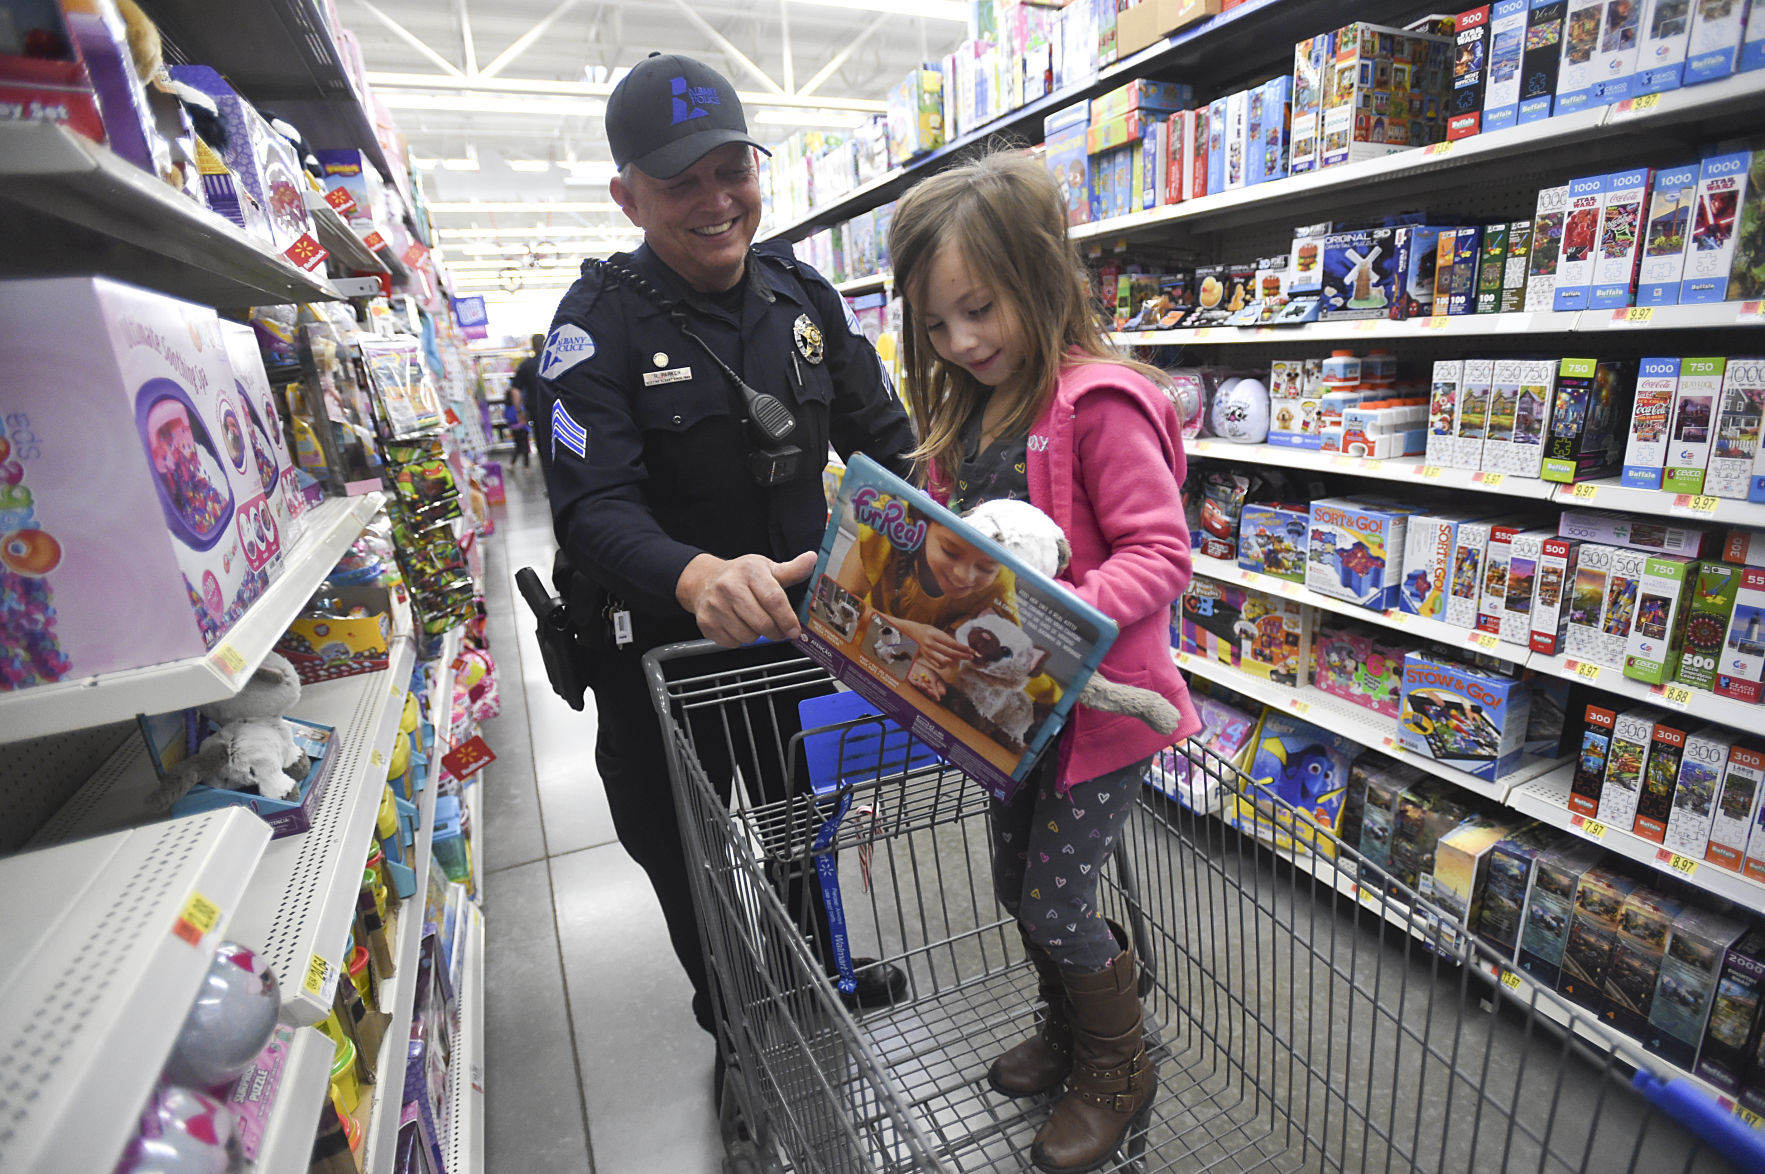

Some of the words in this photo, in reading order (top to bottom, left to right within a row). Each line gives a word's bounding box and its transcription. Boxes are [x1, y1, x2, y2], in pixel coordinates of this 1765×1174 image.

[1498, 1, 1523, 14] 1000
[1461, 12, 1482, 26] 500
[1456, 32, 1484, 46] WARS
[1460, 26, 1484, 39] STAR
[1522, 102, 1547, 113] Buffalo
[1635, 95, 1658, 110] 9.97
[1451, 118, 1475, 129] Buffalo
[1707, 160, 1741, 174] 1000
[1612, 174, 1641, 187] 1000
[1660, 173, 1692, 186] 1000
[1708, 177, 1736, 187] STAR
[1574, 181, 1600, 193] 1000
[1705, 181, 1736, 192] WARS
[1539, 189, 1568, 209] 1000
[1573, 200, 1597, 209] WARS
[1574, 196, 1597, 205] STAR
[1324, 234, 1371, 245] ORIGINAL
[1373, 229, 1391, 238] 3D
[1479, 294, 1495, 302] 100
[1597, 288, 1623, 298] Buffalo
[1451, 296, 1466, 304] 100
[1629, 309, 1652, 321] 9.97
[557, 336, 586, 346] ALBANY
[556, 344, 584, 355] POLICE
[1435, 364, 1457, 378] 750
[1498, 365, 1521, 379] 750
[1524, 366, 1549, 381] 750
[1568, 364, 1589, 374] 750
[1645, 364, 1674, 374] 1000
[1690, 362, 1714, 372] 750
[1547, 464, 1571, 473] Buffalo
[1628, 470, 1656, 479] Buffalo
[1575, 486, 1595, 497] 9.97
[1693, 498, 1716, 510] 9.97
[1314, 507, 1347, 529] SORT
[1346, 515, 1354, 527] &
[1356, 516, 1383, 534] GO!
[1460, 530, 1483, 544] 500
[1495, 531, 1513, 541] 550
[1568, 527, 1589, 537] 500
[1435, 524, 1452, 556] SORT
[1513, 540, 1539, 555] 500
[1545, 544, 1566, 554] 500
[1730, 537, 1743, 558] 300
[1436, 557, 1443, 566] &
[1582, 549, 1609, 566] 500
[1653, 564, 1675, 575] 750
[1433, 568, 1446, 592] GO!
[1747, 575, 1765, 585] 55
[1366, 653, 1385, 677] 6
[1682, 653, 1715, 671] 500
[1580, 664, 1598, 676] 8.97
[1406, 669, 1454, 688] STOW
[1454, 679, 1465, 691] &
[1466, 683, 1503, 710] GO!
[1729, 681, 1755, 691] CEACO
[1667, 687, 1689, 703] 8.88
[1589, 712, 1611, 724] 300
[1226, 722, 1243, 743] 4
[1617, 721, 1647, 740] 300
[1657, 730, 1681, 743] 300
[1687, 742, 1721, 763] 300
[1733, 751, 1760, 765] 300
[1732, 765, 1754, 775] LARGE
[1574, 797, 1593, 810] Buffalo
[1585, 821, 1604, 836] 7.97
[1639, 819, 1661, 832] Buffalo
[1711, 845, 1736, 859] Buffalo
[1673, 856, 1695, 872] 8.97
[834, 934, 848, 971] Walmart
[1728, 953, 1764, 975] 2000
[234, 1062, 256, 1104] SURPRISE
[250, 1070, 268, 1102] PUZZLE
